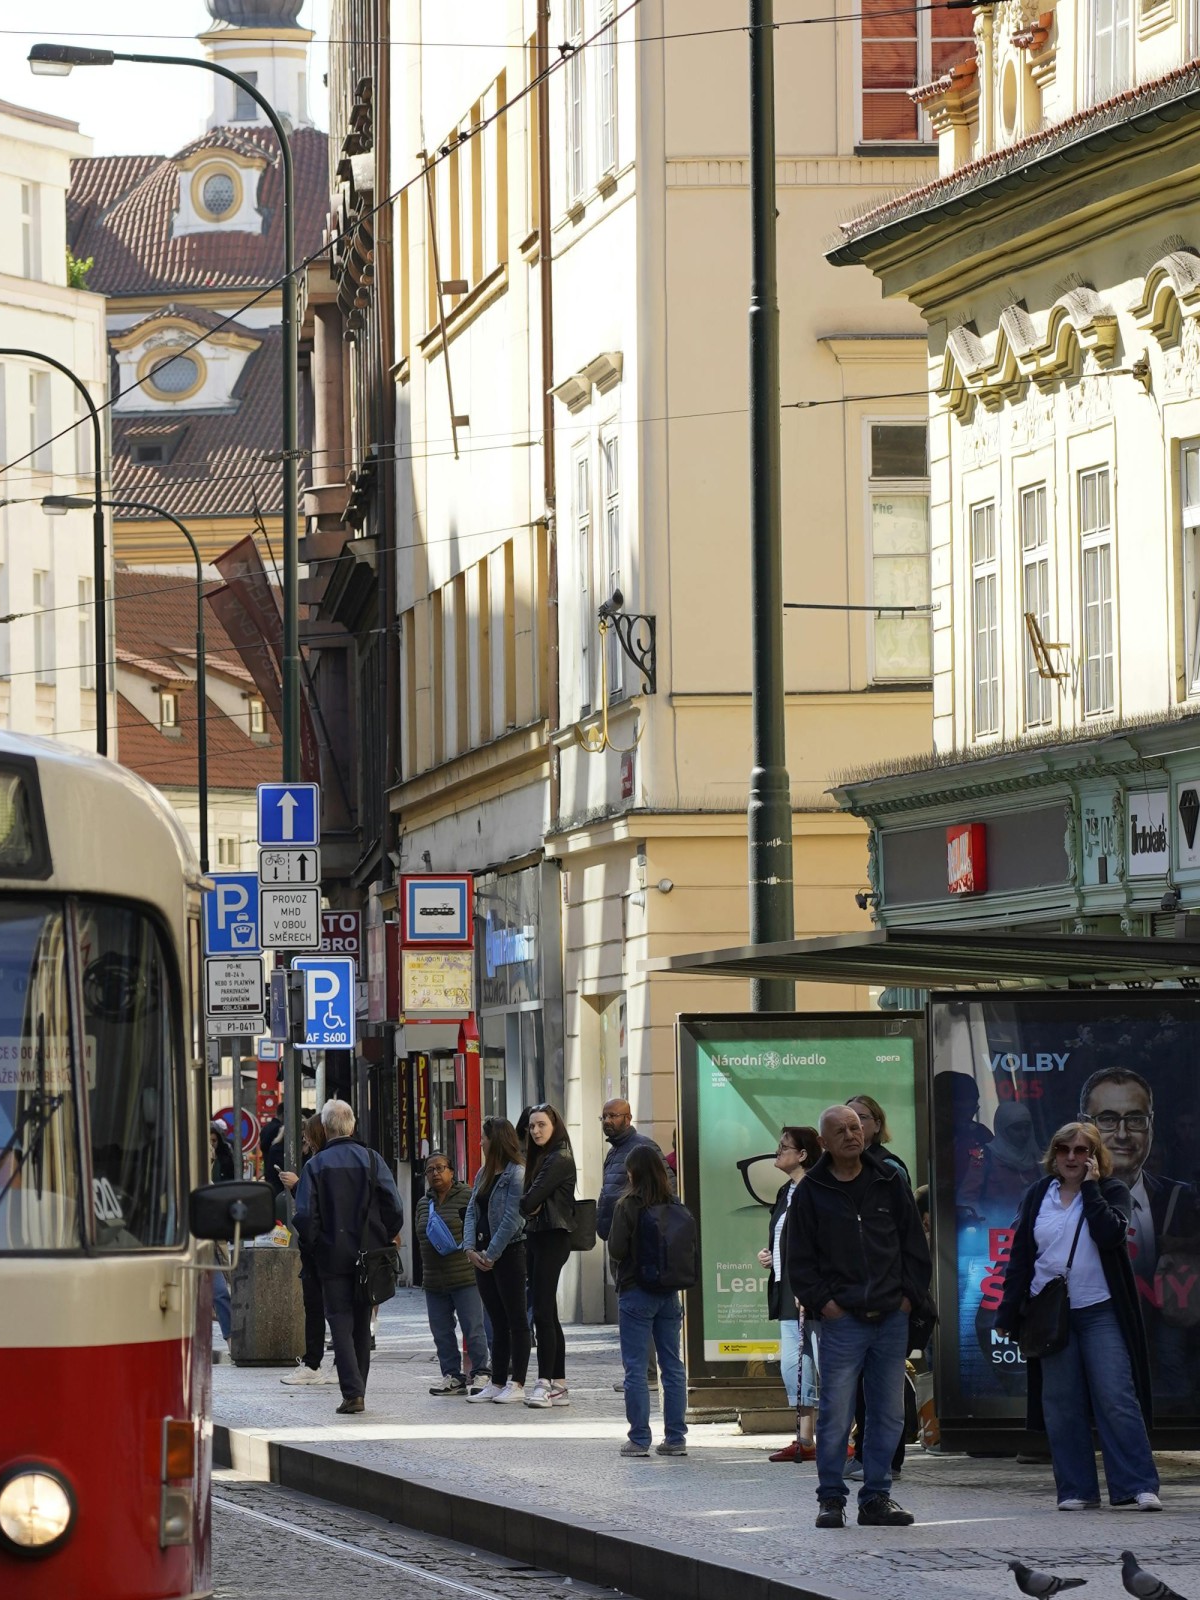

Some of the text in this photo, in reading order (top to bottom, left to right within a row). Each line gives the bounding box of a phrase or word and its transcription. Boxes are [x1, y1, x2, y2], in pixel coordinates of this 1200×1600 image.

[272, 895, 307, 904] PROVOZ
[216, 884, 249, 929] P
[280, 908, 301, 916] MHD
[273, 921, 307, 929] V OBOU
[269, 931, 311, 942] SMĚRECH
[321, 937, 358, 951] BRO
[307, 970, 340, 1020] P
[227, 1022, 256, 1031] P1-0411
[306, 1033, 347, 1042] AF S600
[711, 1053, 827, 1066] Národní divadlo
[875, 1054, 901, 1062] opera
[982, 1052, 1070, 1072] VOLBY
[716, 1262, 753, 1270] Reimann
[716, 1272, 769, 1293] Lear
